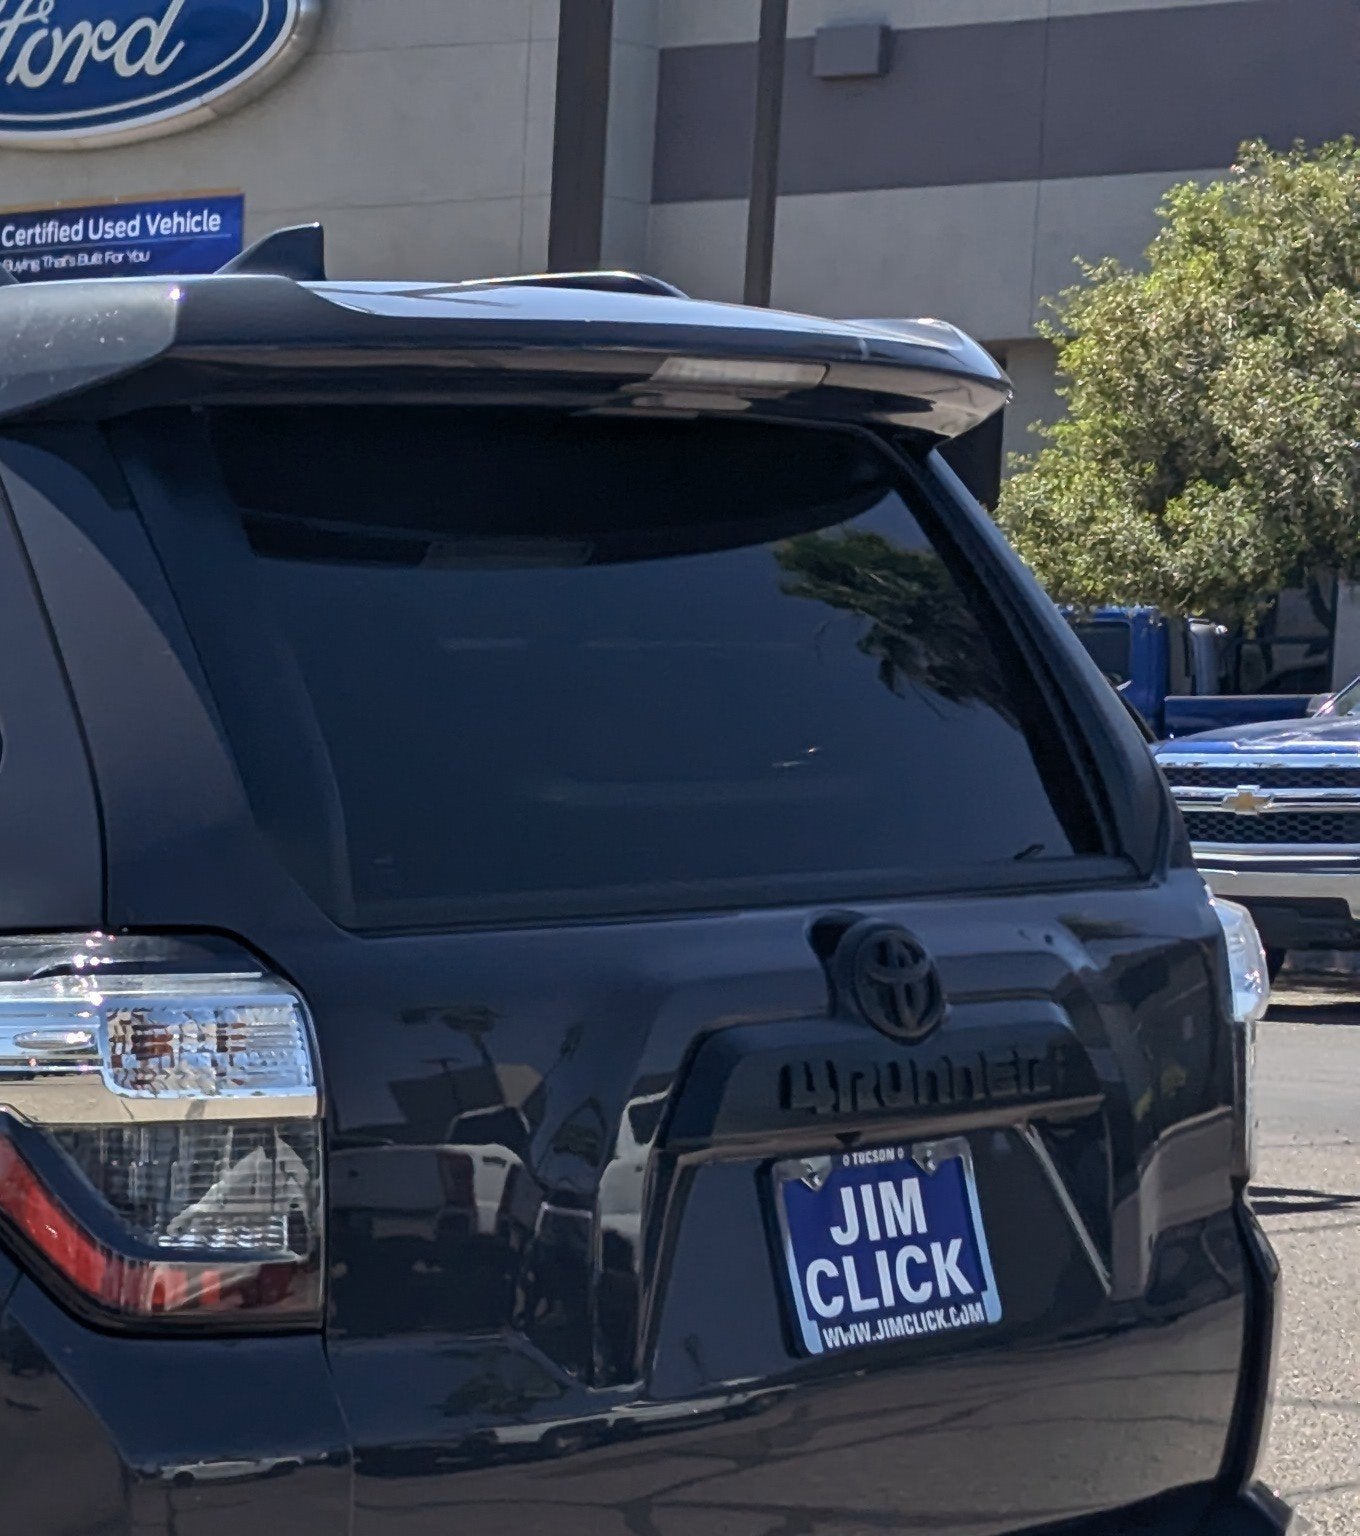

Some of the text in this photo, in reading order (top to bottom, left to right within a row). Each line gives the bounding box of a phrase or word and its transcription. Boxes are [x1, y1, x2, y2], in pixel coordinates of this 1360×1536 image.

[1, 218, 84, 248] Certified
[88, 214, 142, 241] Used
[147, 209, 222, 237] Vehicle
[104, 250, 125, 264] For
[126, 249, 151, 263] You
[851, 1147, 895, 1166] TUCSON
[830, 1177, 928, 1246] JIM
[805, 1237, 975, 1319] CLICK
[822, 1302, 986, 1349] WWW.JIMCLICK.COM
